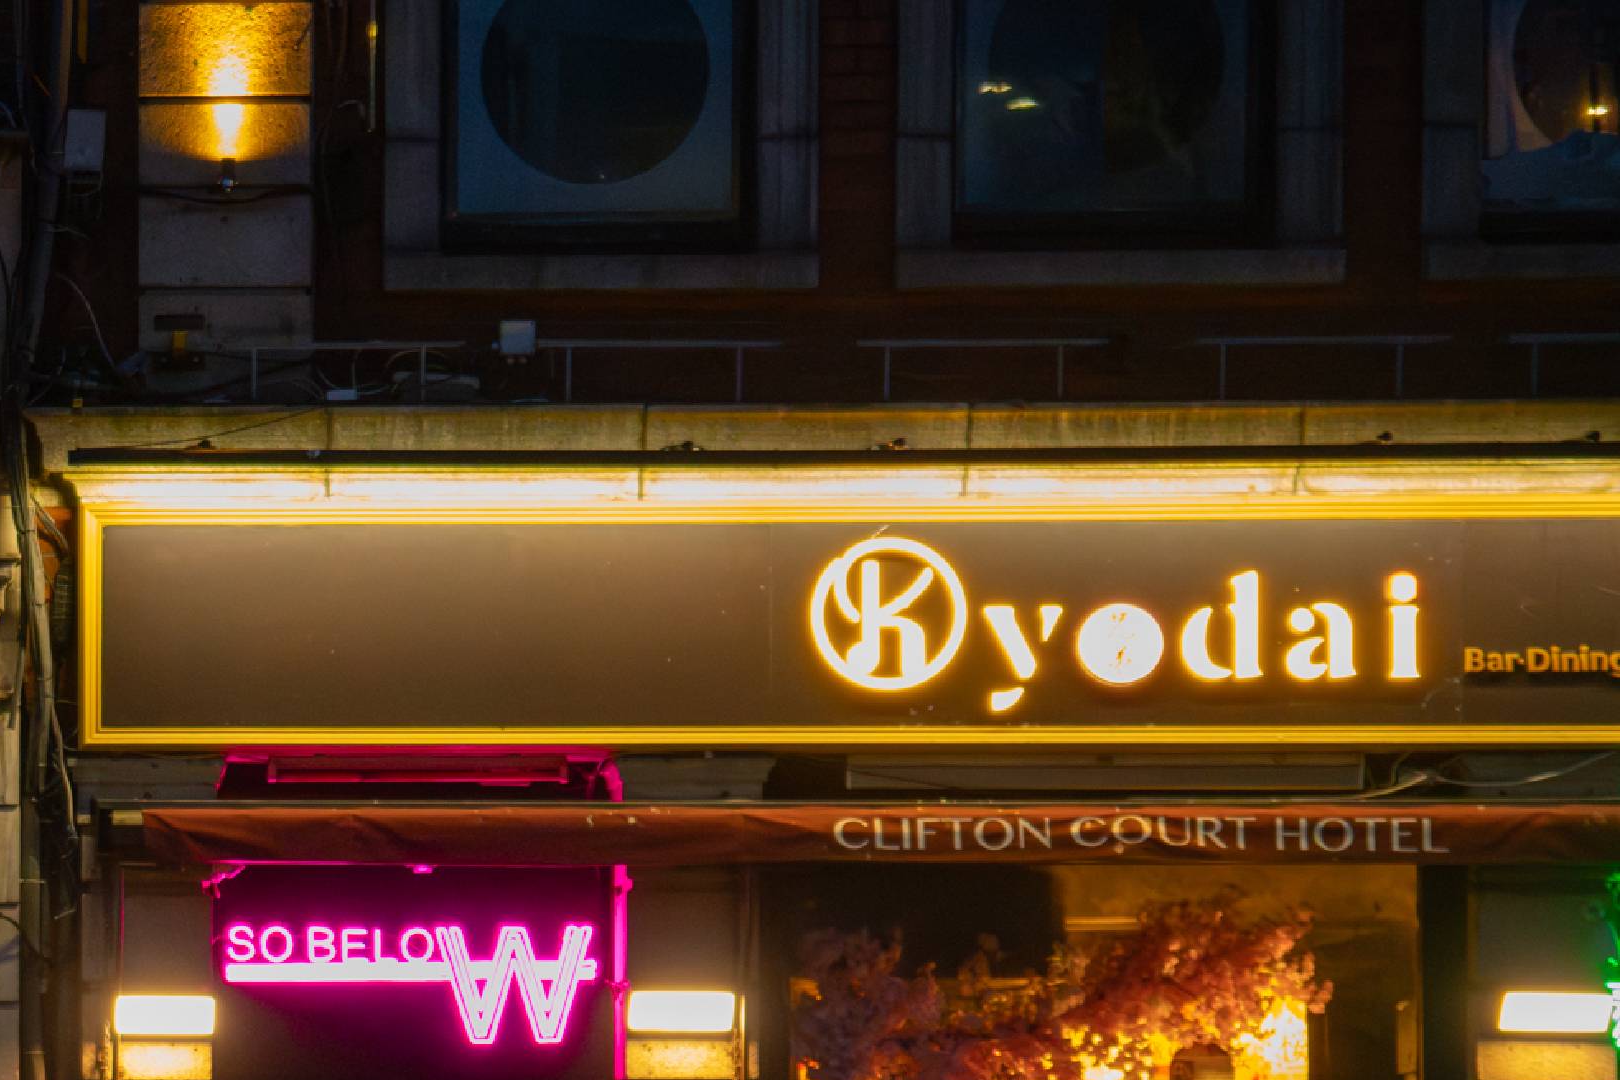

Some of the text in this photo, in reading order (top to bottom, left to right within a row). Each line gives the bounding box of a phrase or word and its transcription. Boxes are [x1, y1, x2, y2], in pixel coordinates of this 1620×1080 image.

[811, 536, 1422, 714] Kyodai
[832, 814, 1452, 853] CLIFTON COURT HOTEL
[225, 924, 594, 1045] SO BELOW
